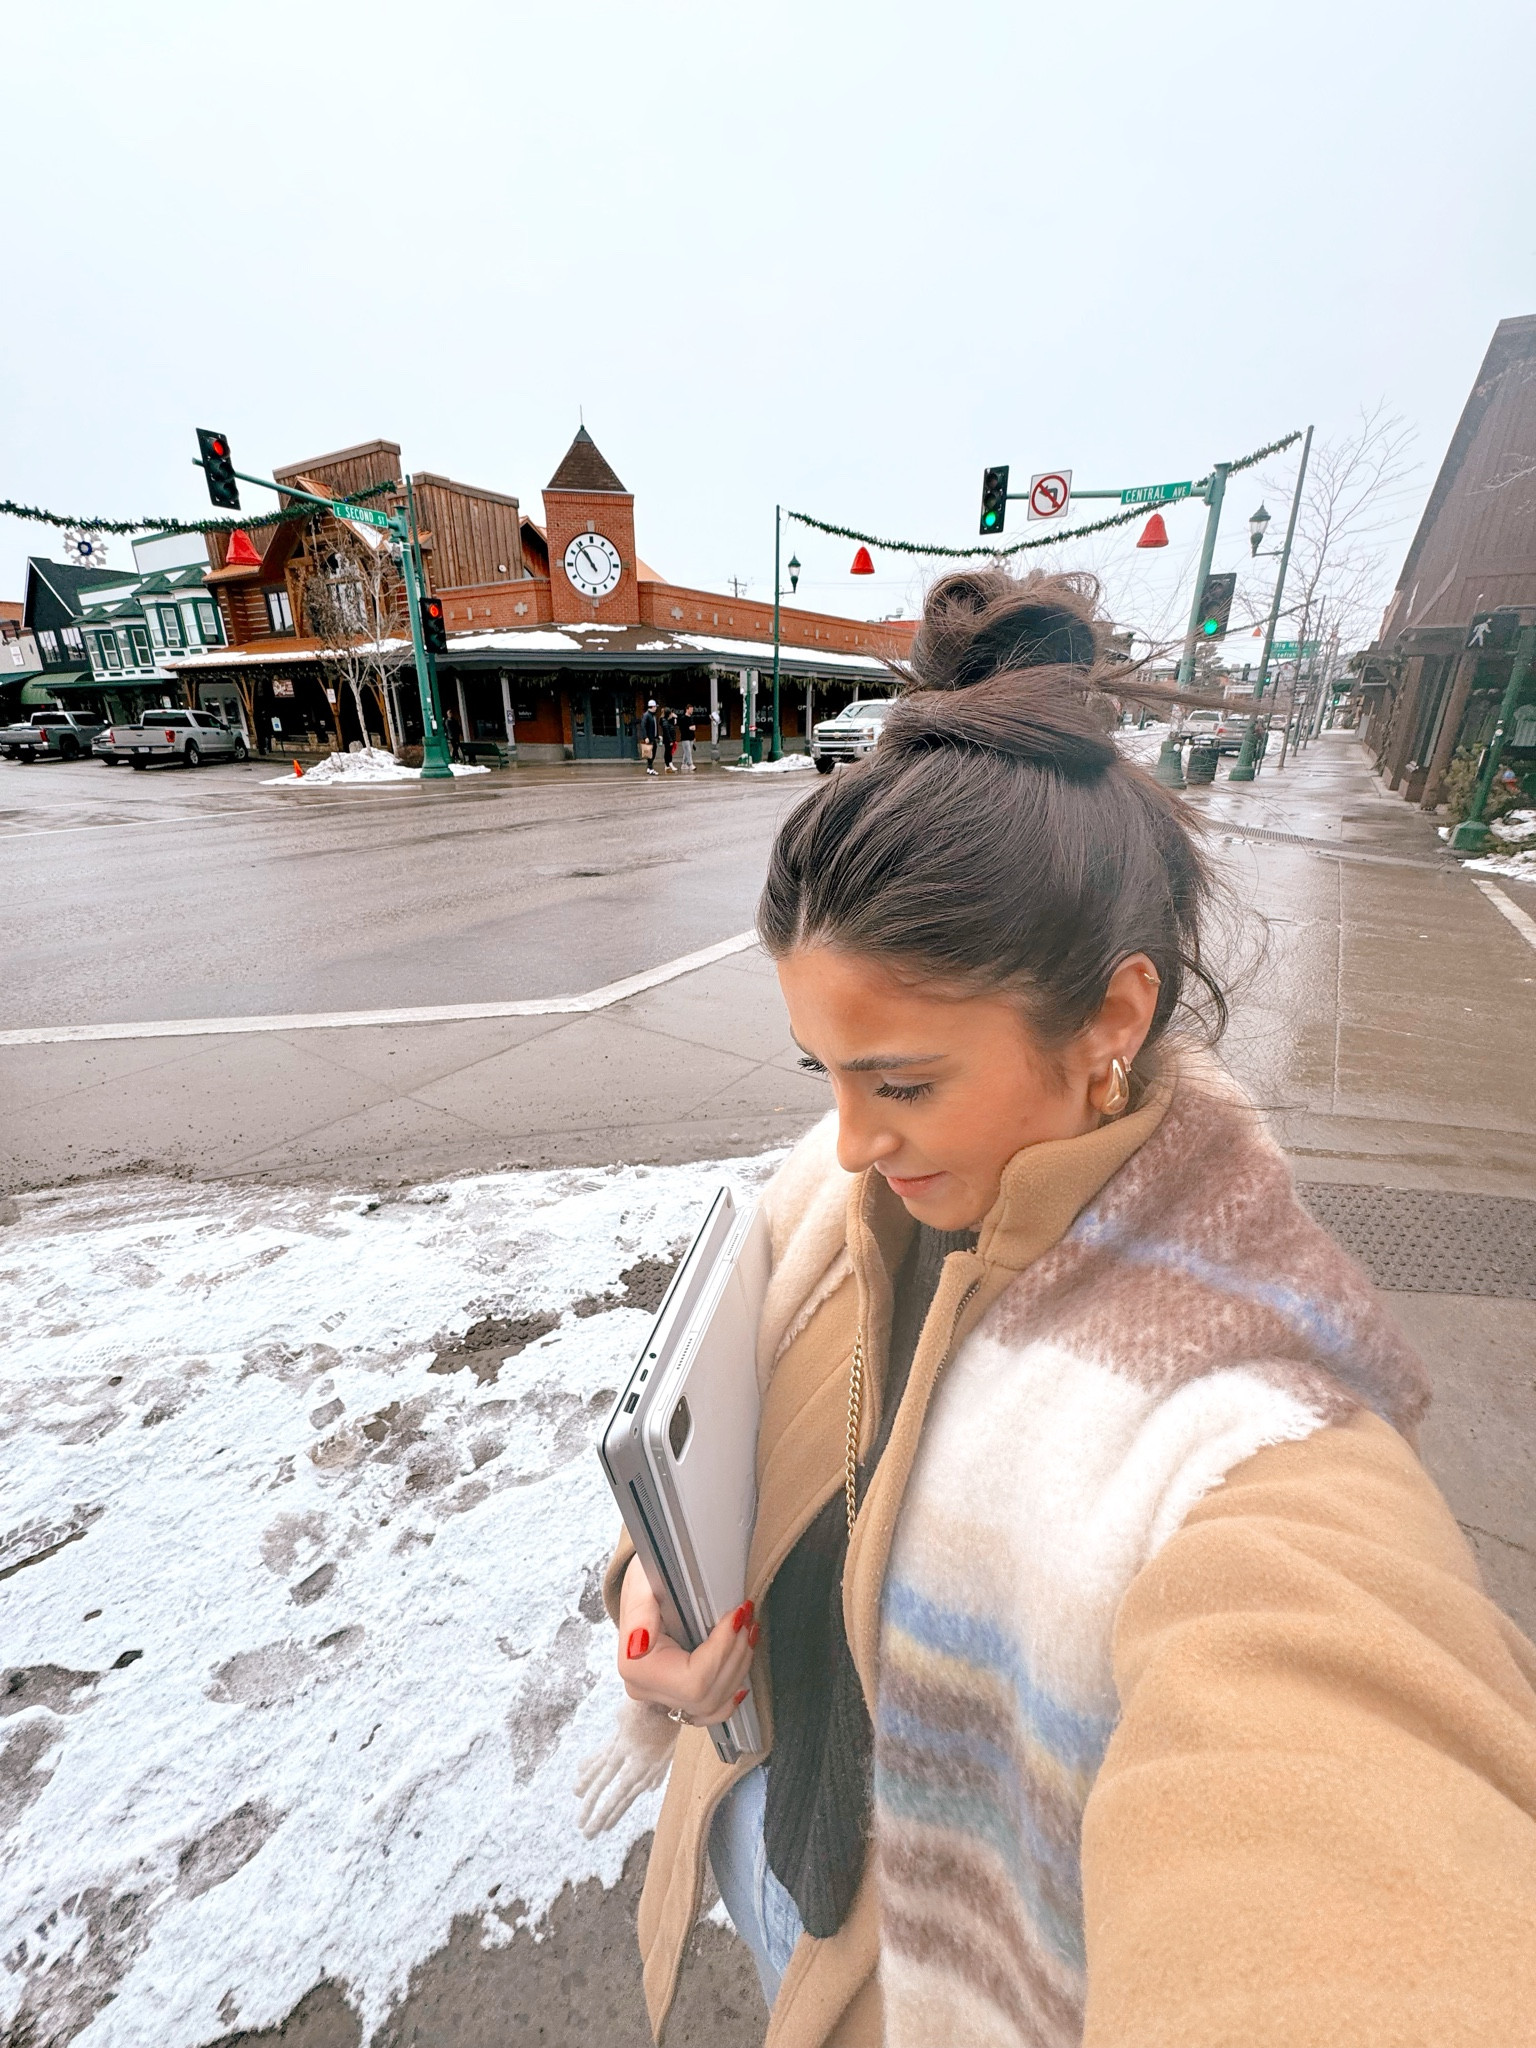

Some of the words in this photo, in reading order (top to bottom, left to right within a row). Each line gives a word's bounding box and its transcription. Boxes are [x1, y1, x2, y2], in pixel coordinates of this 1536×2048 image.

[1125, 486, 1165, 503] CENTRAL
[1172, 486, 1187, 498] AVE
[336, 507, 341, 517] E
[345, 506, 374, 523] SECOND
[377, 515, 385, 525] ST
